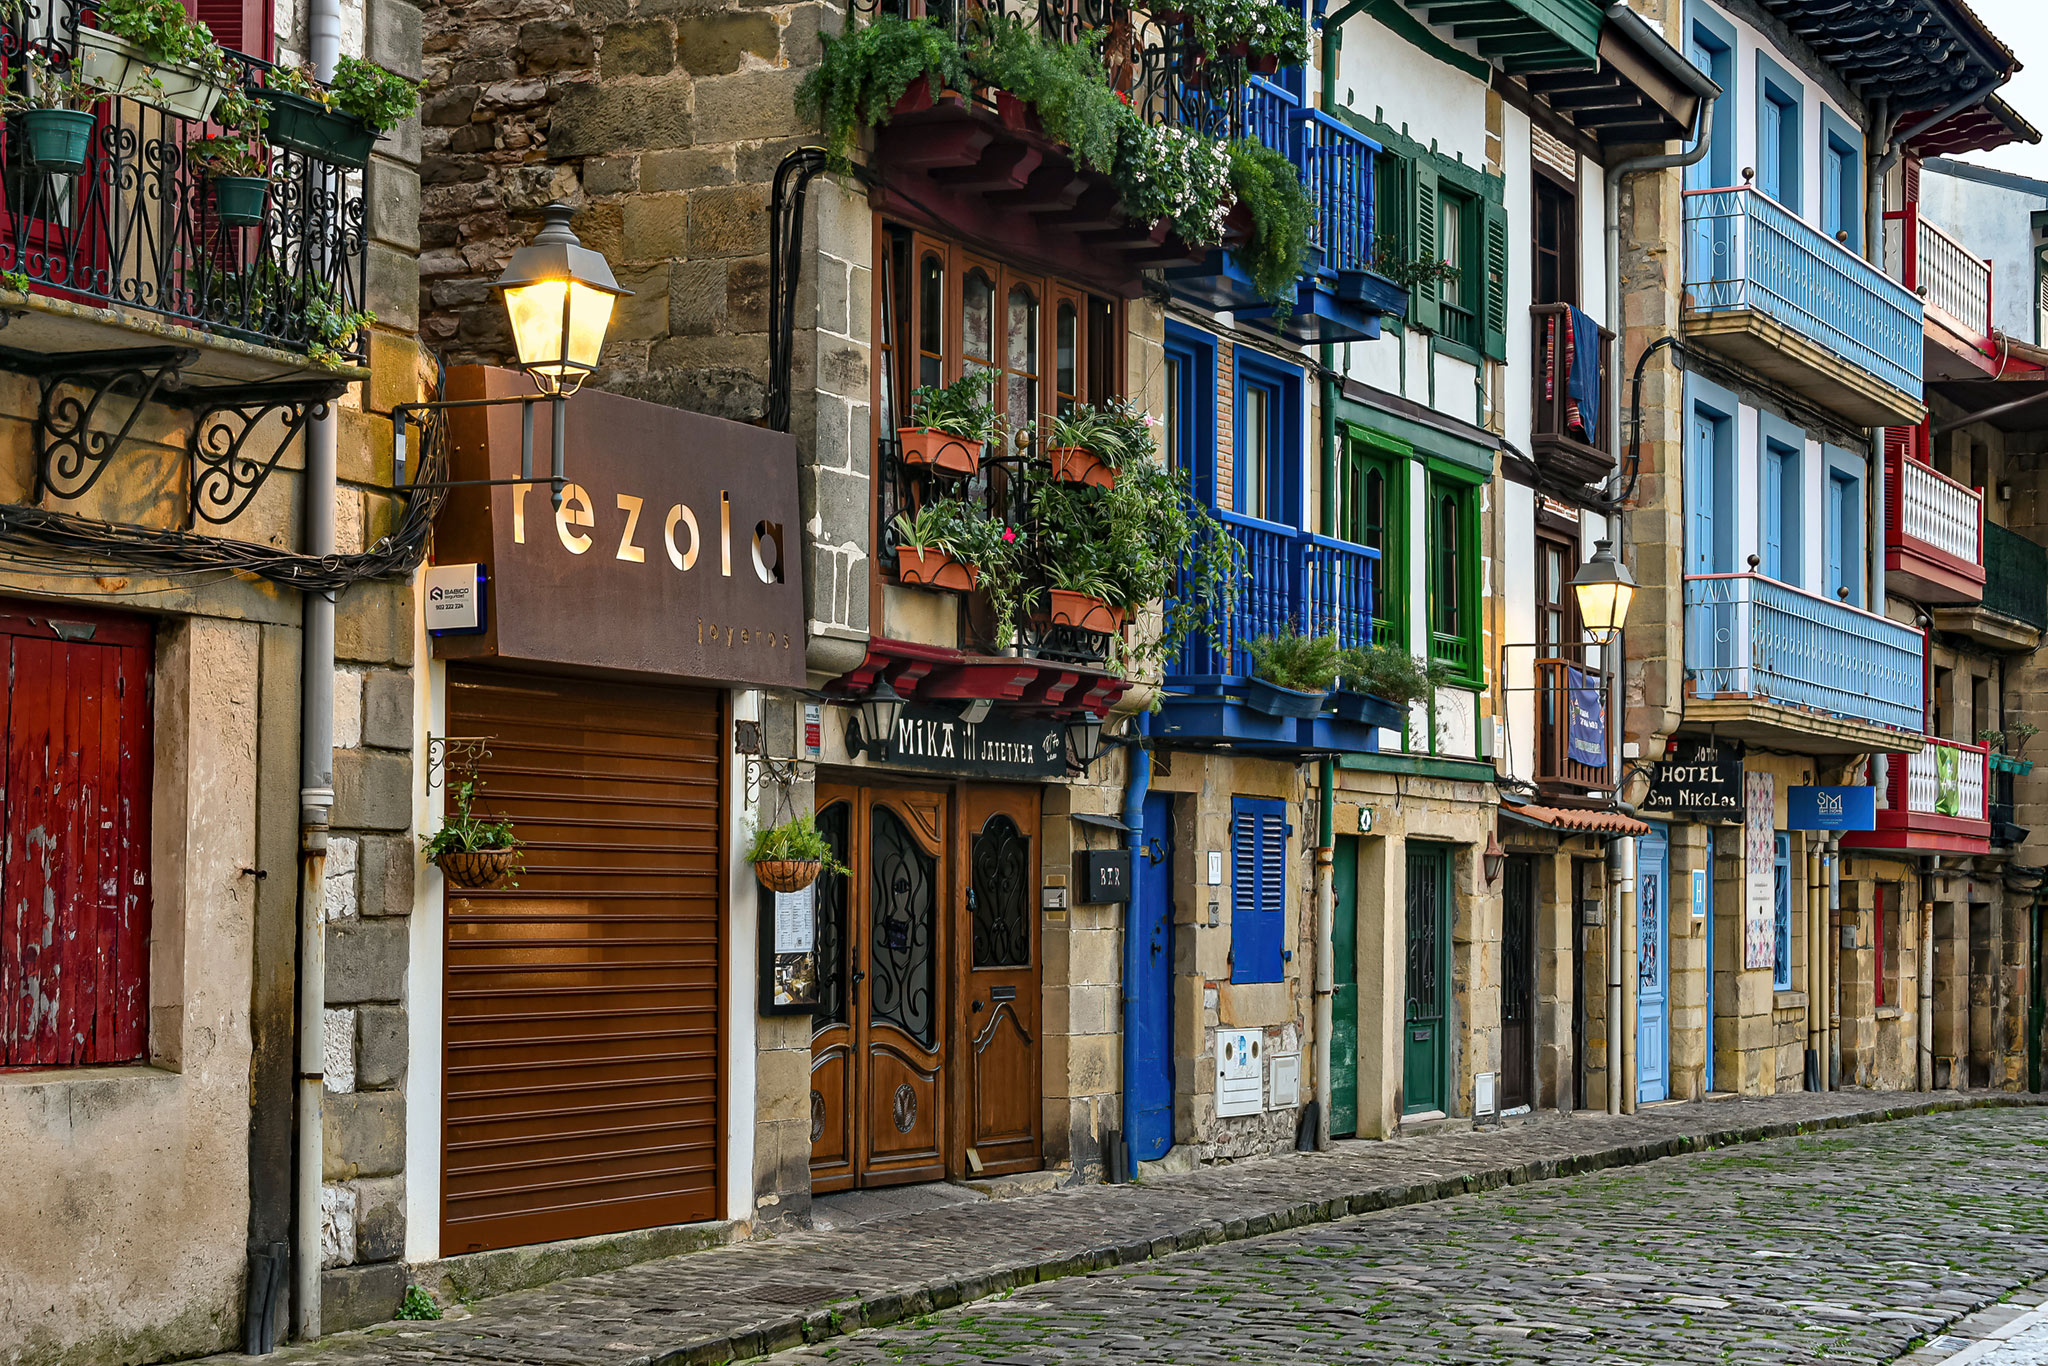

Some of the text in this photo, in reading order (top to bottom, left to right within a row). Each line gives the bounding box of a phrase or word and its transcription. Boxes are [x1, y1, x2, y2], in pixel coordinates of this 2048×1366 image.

[512, 474, 785, 584] rezola
[697, 616, 789, 649] joyeros
[981, 740, 1034, 764] JATETXEA
[1660, 765, 1724, 783] HOTEL
[1648, 789, 1673, 806] San
[1100, 867, 1121, 887] BAR
[1696, 879, 1702, 903] H
